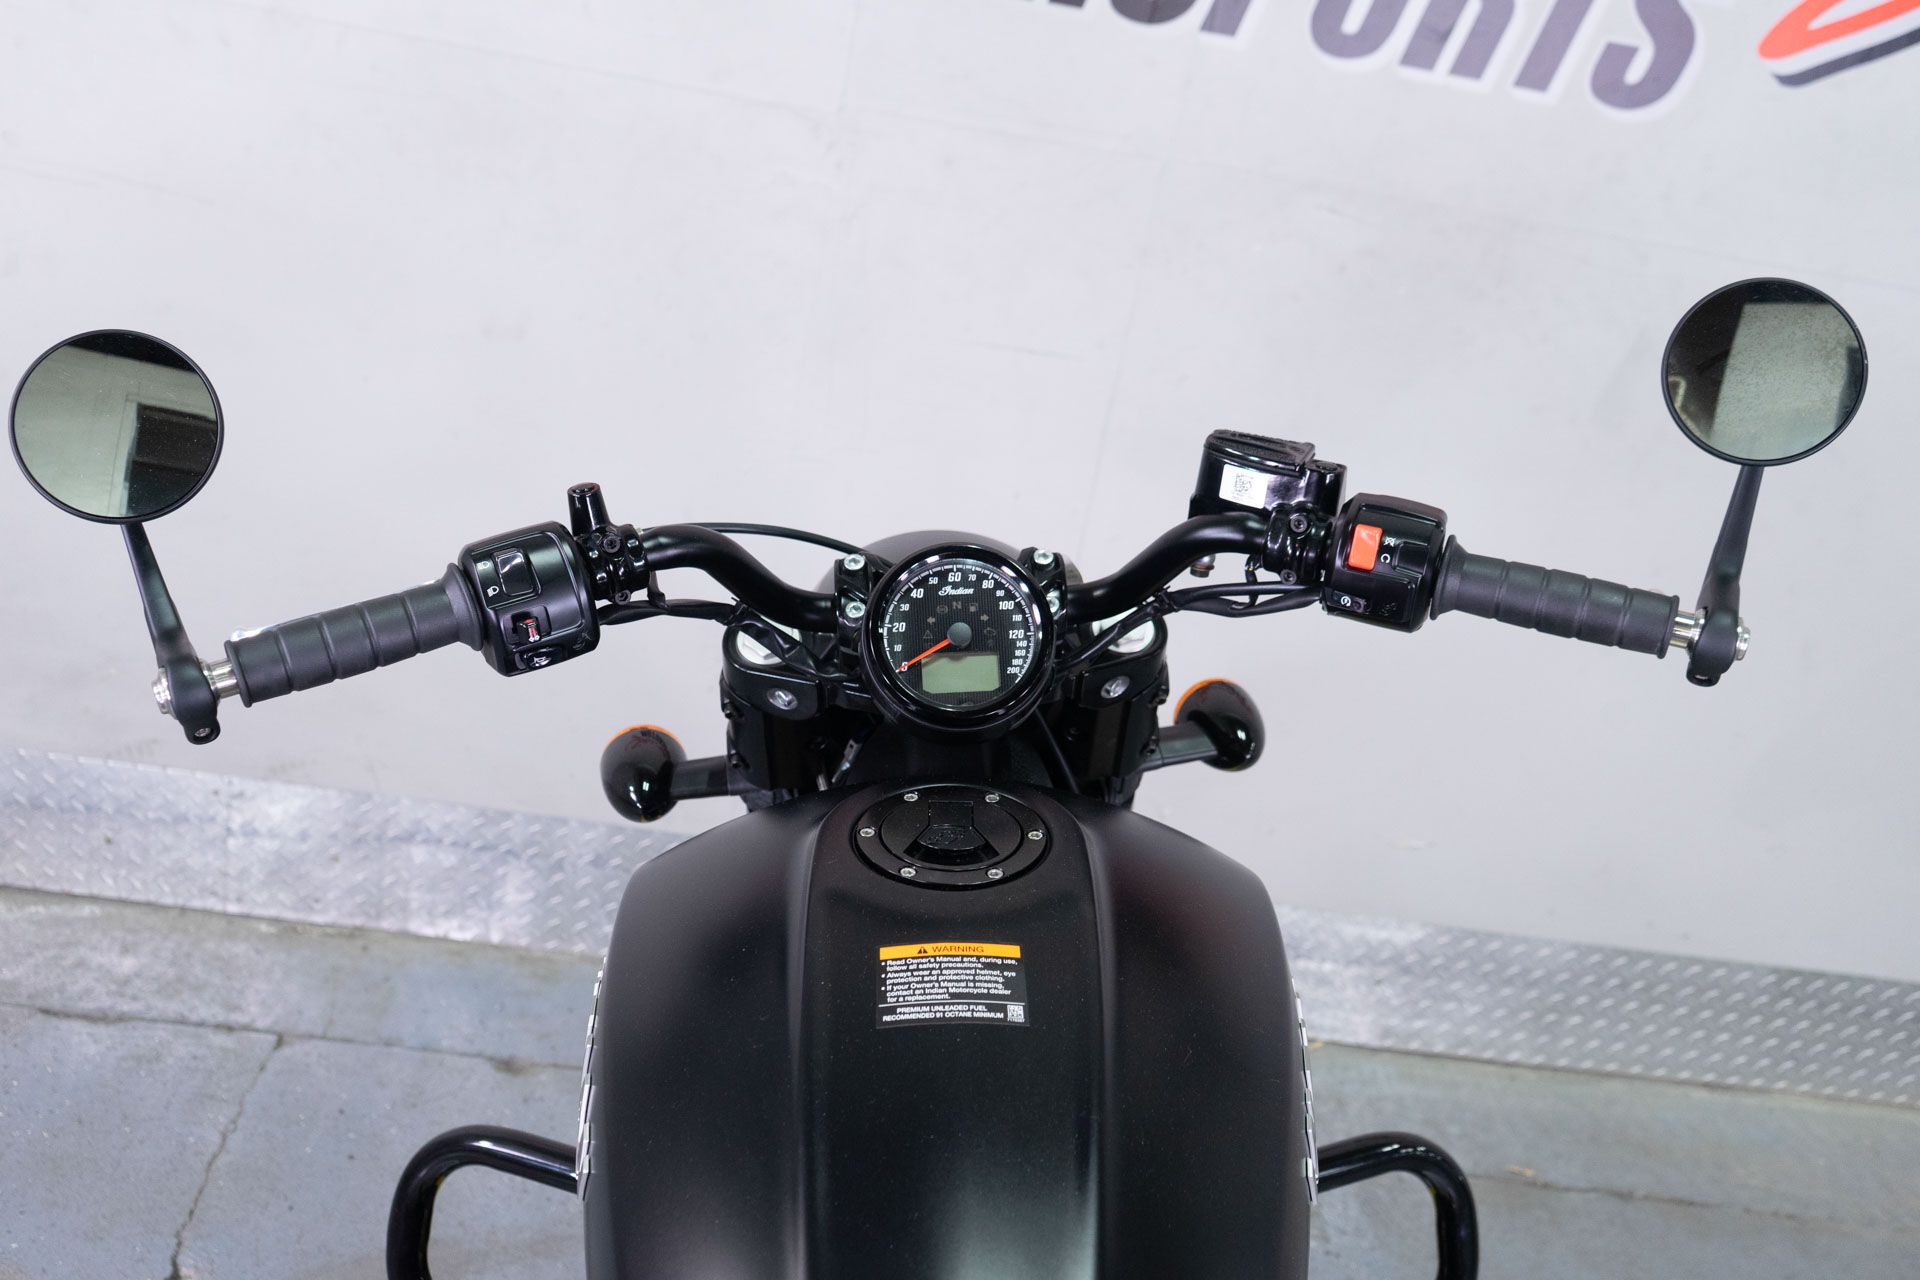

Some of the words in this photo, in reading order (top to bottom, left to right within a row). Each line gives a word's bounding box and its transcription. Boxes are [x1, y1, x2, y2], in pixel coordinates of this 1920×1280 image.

[948, 572, 961, 582] 60
[982, 580, 994, 588] 80
[910, 588, 924, 598] 40
[938, 585, 974, 596] Indian
[900, 604, 910, 612] 30
[998, 600, 1014, 610] 100
[892, 622, 906, 632] 20
[1008, 630, 1024, 639] 120
[887, 976, 922, 985] protection
[883, 1012, 935, 1022] RECOMMENDED
